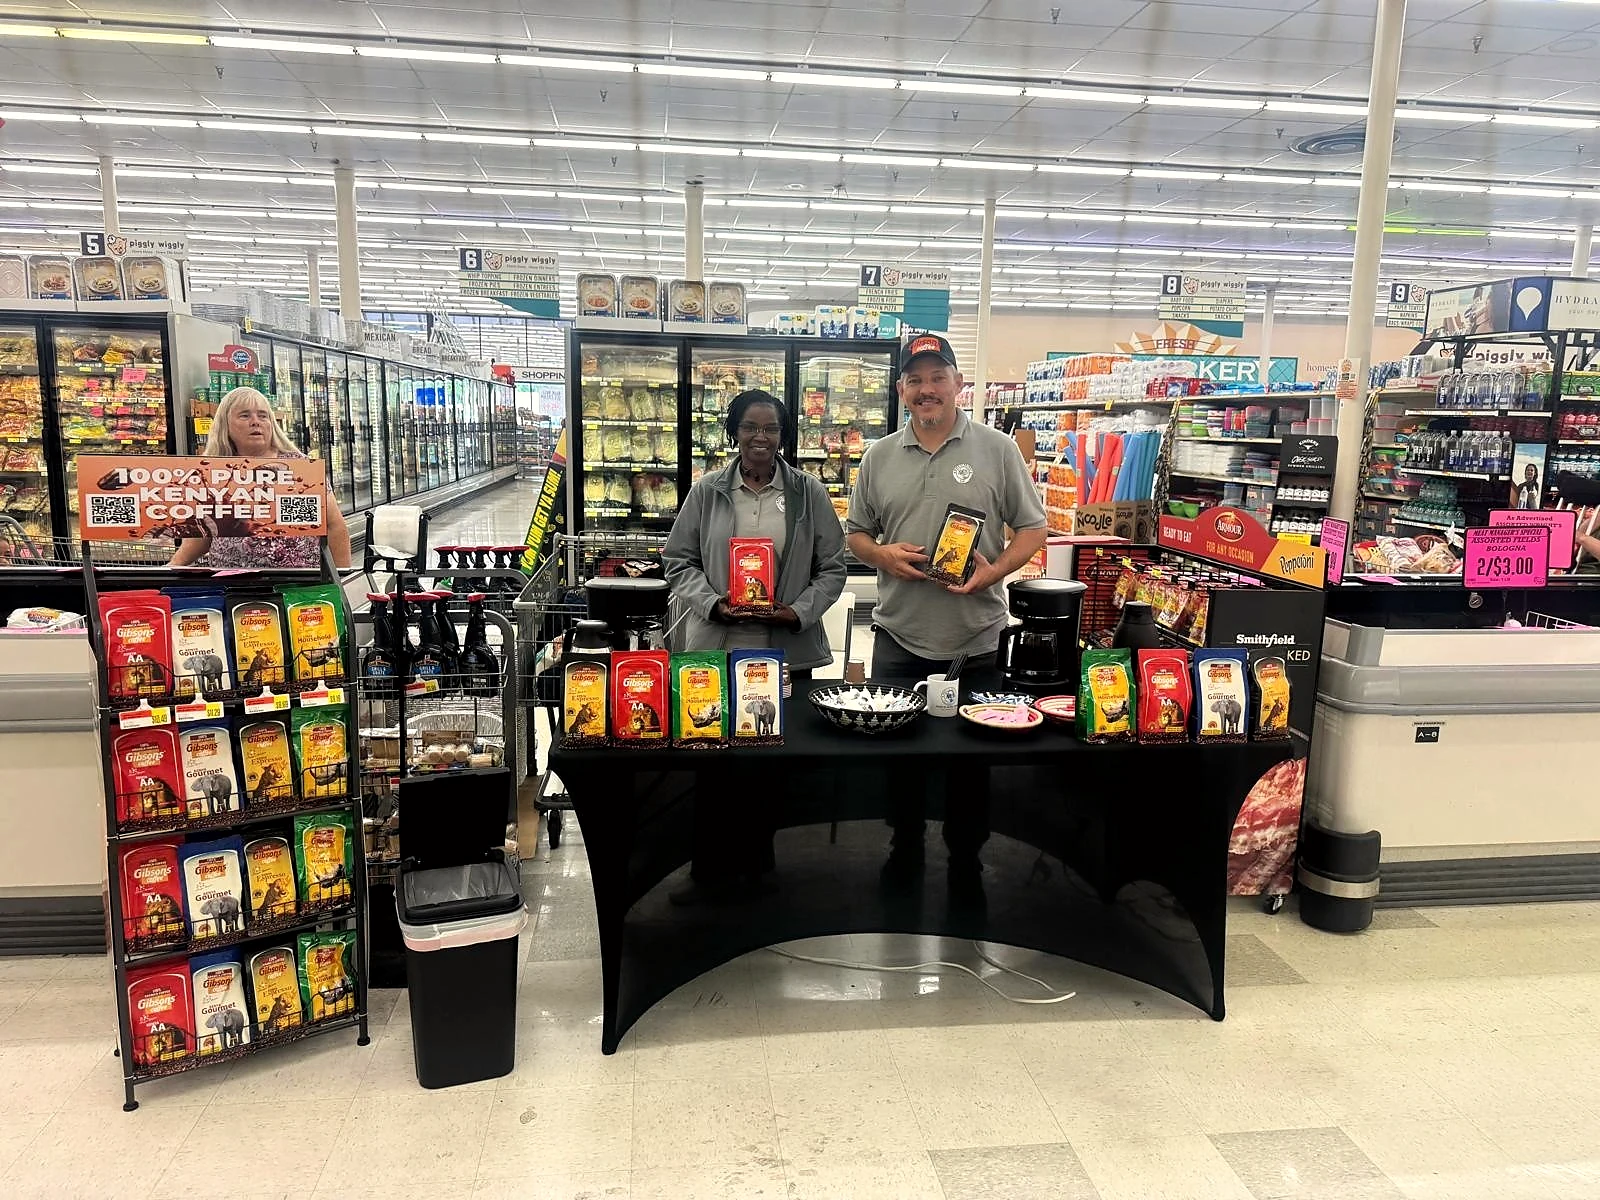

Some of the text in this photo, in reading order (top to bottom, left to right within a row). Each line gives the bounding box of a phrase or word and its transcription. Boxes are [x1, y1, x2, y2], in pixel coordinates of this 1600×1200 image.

[86, 234, 100, 254] 5
[129, 240, 184, 249] piggly wiggly
[465, 250, 477, 268] 6
[505, 255, 556, 264] piggly wiggly
[866, 267, 877, 285] 7
[902, 272, 948, 280] piggly wiggly
[1166, 276, 1178, 294] 8
[1224, 281, 1244, 289] wiggly
[1395, 285, 1405, 302] 9
[364, 332, 396, 342] MEXICAN
[1156, 338, 1196, 350] FRESH
[412, 346, 432, 354] BREAD
[115, 468, 294, 485] 100% PURE
[139, 487, 276, 502] KENYAN
[146, 504, 271, 520] COFFEE
[1217, 520, 1242, 536] ARMOUR
[1520, 528, 1542, 536] SPECIAL
[1164, 526, 1192, 544] READY TO EAT
[1472, 536, 1512, 544] ASSORTED
[1206, 541, 1254, 564] FOR ANY OCCASION
[1279, 552, 1314, 575] Pepperoni
[1477, 556, 1533, 576] 2/$3.00
[178, 622, 210, 632] Gibsons
[240, 618, 271, 627] Gibsons
[116, 628, 155, 638] Gibsons
[1236, 634, 1296, 648] Smithfield
[178, 648, 216, 657] Gourmet
[1287, 650, 1311, 662] KED
[128, 654, 144, 663] AA
[744, 669, 770, 679] Gibsons
[1208, 670, 1232, 679] Gibsons
[623, 678, 654, 688] Gibsons
[631, 702, 644, 710] AA
[1160, 698, 1172, 706] AA
[248, 734, 278, 744] Gibsons
[186, 742, 218, 752] Gibsons
[126, 752, 164, 763] Gibsons
[186, 768, 224, 778] Gourmet
[140, 778, 155, 787] AA
[253, 850, 282, 860] Gibsons
[134, 867, 172, 878] Gibsons
[195, 864, 226, 875] Gibsons
[146, 894, 162, 904] AA
[196, 890, 232, 902] Gourmet
[260, 963, 288, 976] Gibsons
[138, 996, 176, 1010] Gibsons
[202, 1002, 236, 1015] Gourmet
[150, 1022, 166, 1034] AA
